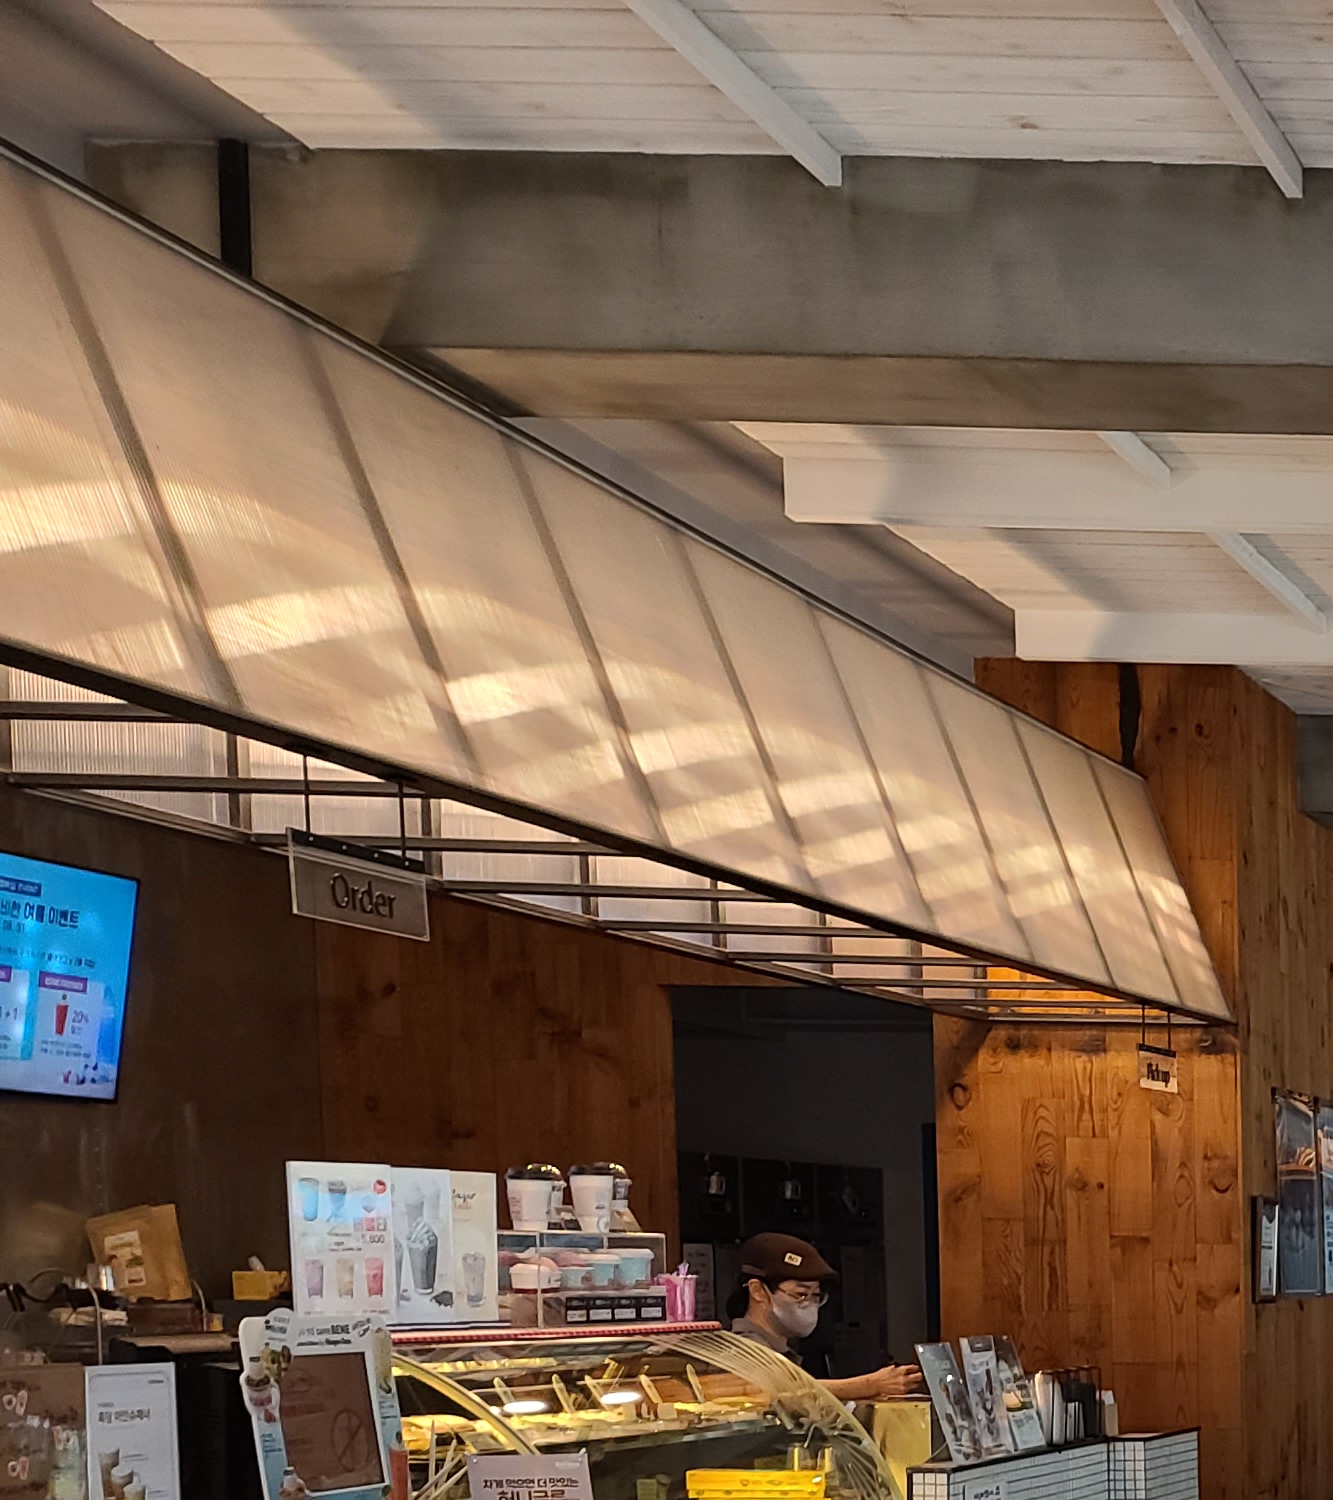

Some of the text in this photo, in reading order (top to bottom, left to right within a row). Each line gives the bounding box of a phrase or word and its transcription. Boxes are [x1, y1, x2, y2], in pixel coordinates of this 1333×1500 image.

[330, 871, 396, 919] Order
[48, 906, 80, 929] 이벤트
[537, 1478, 547, 1488] 더
[549, 1477, 580, 1488] 맛있는
